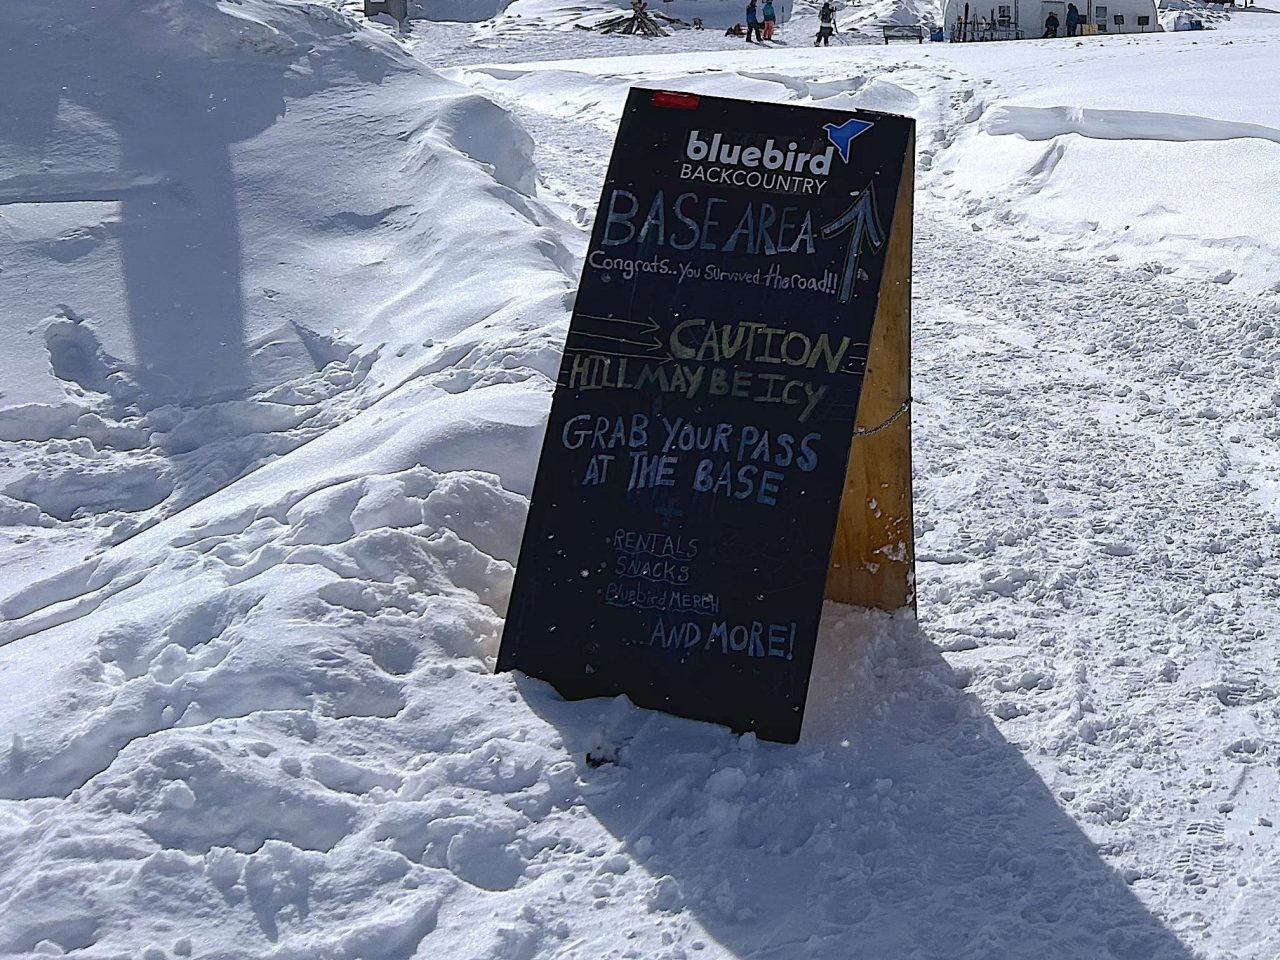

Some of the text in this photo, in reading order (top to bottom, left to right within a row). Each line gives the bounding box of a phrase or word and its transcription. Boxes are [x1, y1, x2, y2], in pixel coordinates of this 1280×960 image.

[686, 130, 834, 176] bluebird
[680, 163, 828, 196] BACKCOUNTRY
[600, 188, 817, 256] BASE AREA
[678, 262, 701, 284] You
[670, 319, 851, 374] CAUTION
[569, 353, 828, 423] HILL MAY BE ICY
[562, 414, 822, 472] GRAB YOUR PASS
[582, 450, 785, 507] AT THE BASE
[613, 529, 699, 558] RENTALS
[615, 556, 690, 581] SNACKS
[605, 582, 720, 613] Bluebird MERCH
[704, 621, 797, 660] MORE!
